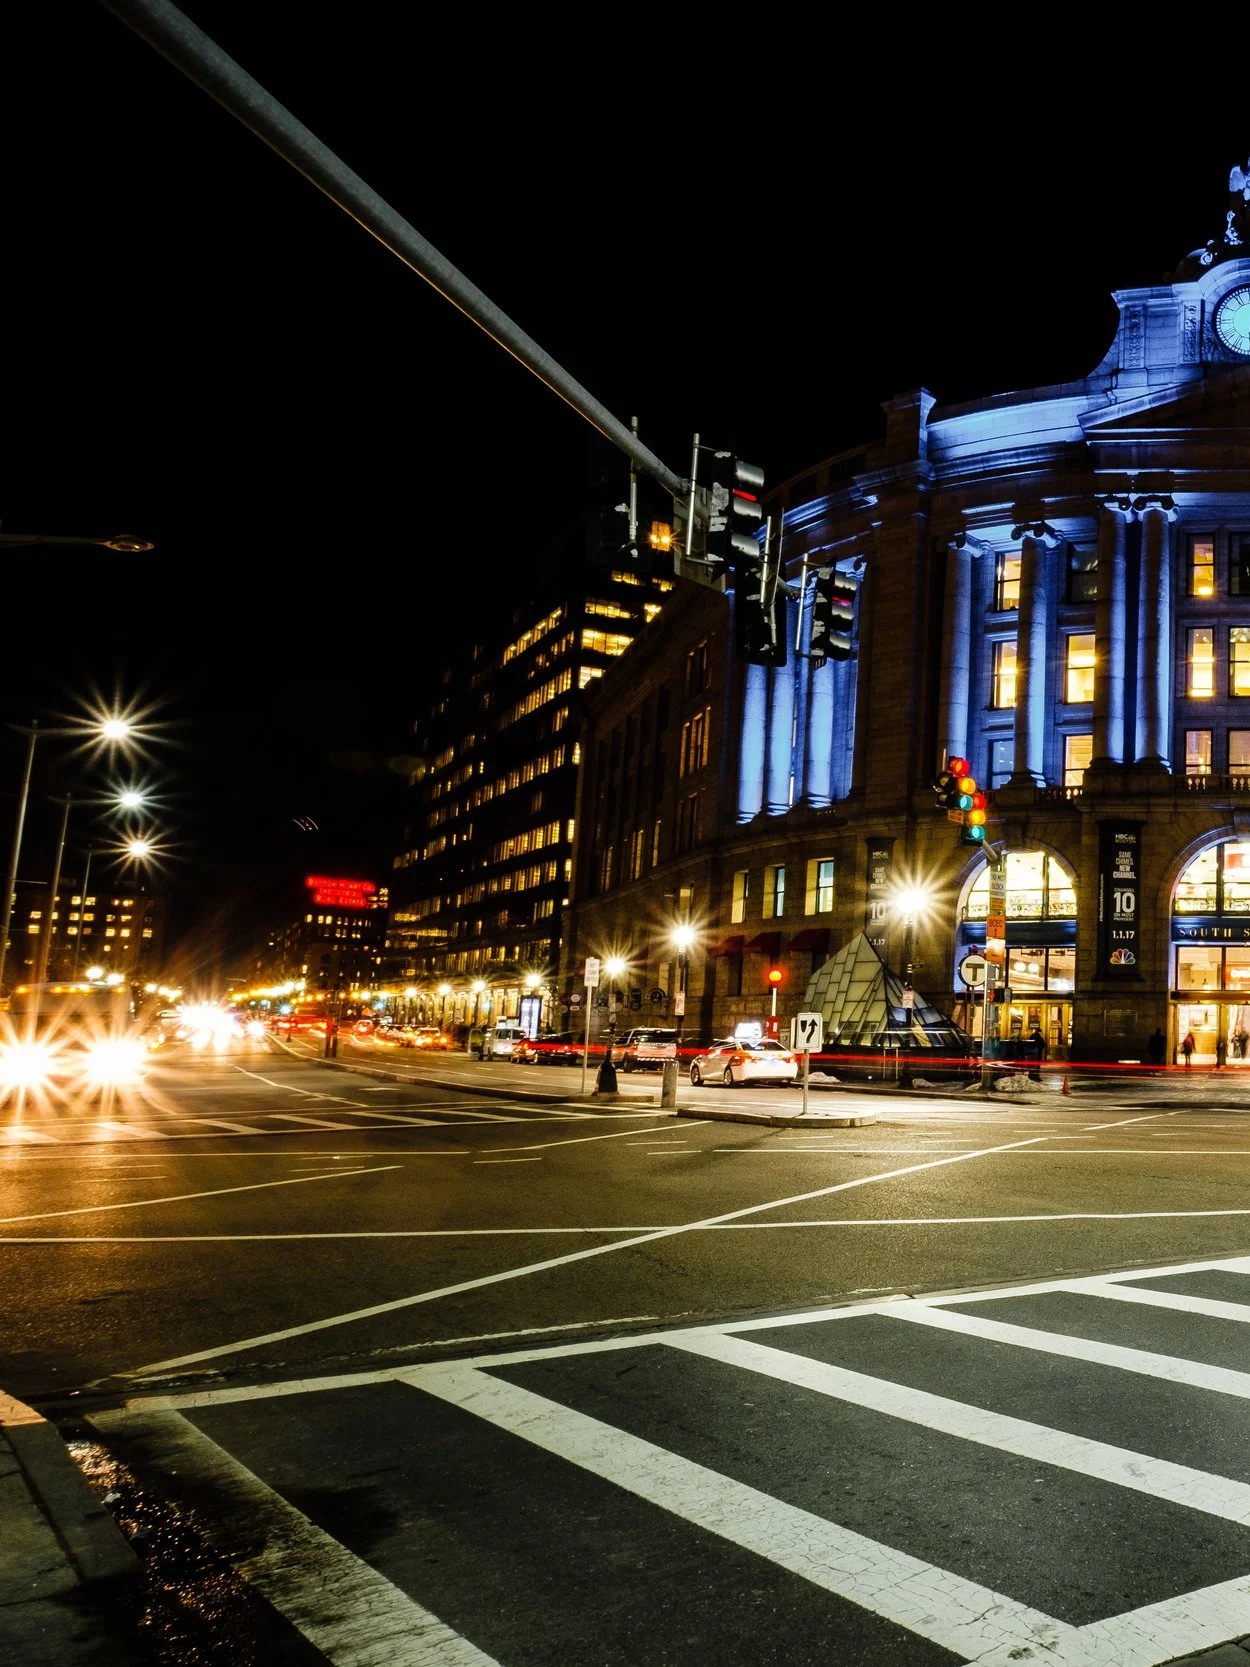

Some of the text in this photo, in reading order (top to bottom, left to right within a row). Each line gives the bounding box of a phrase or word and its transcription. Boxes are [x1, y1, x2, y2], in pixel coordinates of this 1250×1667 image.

[870, 902, 887, 919] 10
[1113, 892, 1136, 913] 10
[1112, 930, 1135, 939] 1.1.17
[1179, 927, 1232, 938] SOUTH
[966, 963, 985, 981] T
